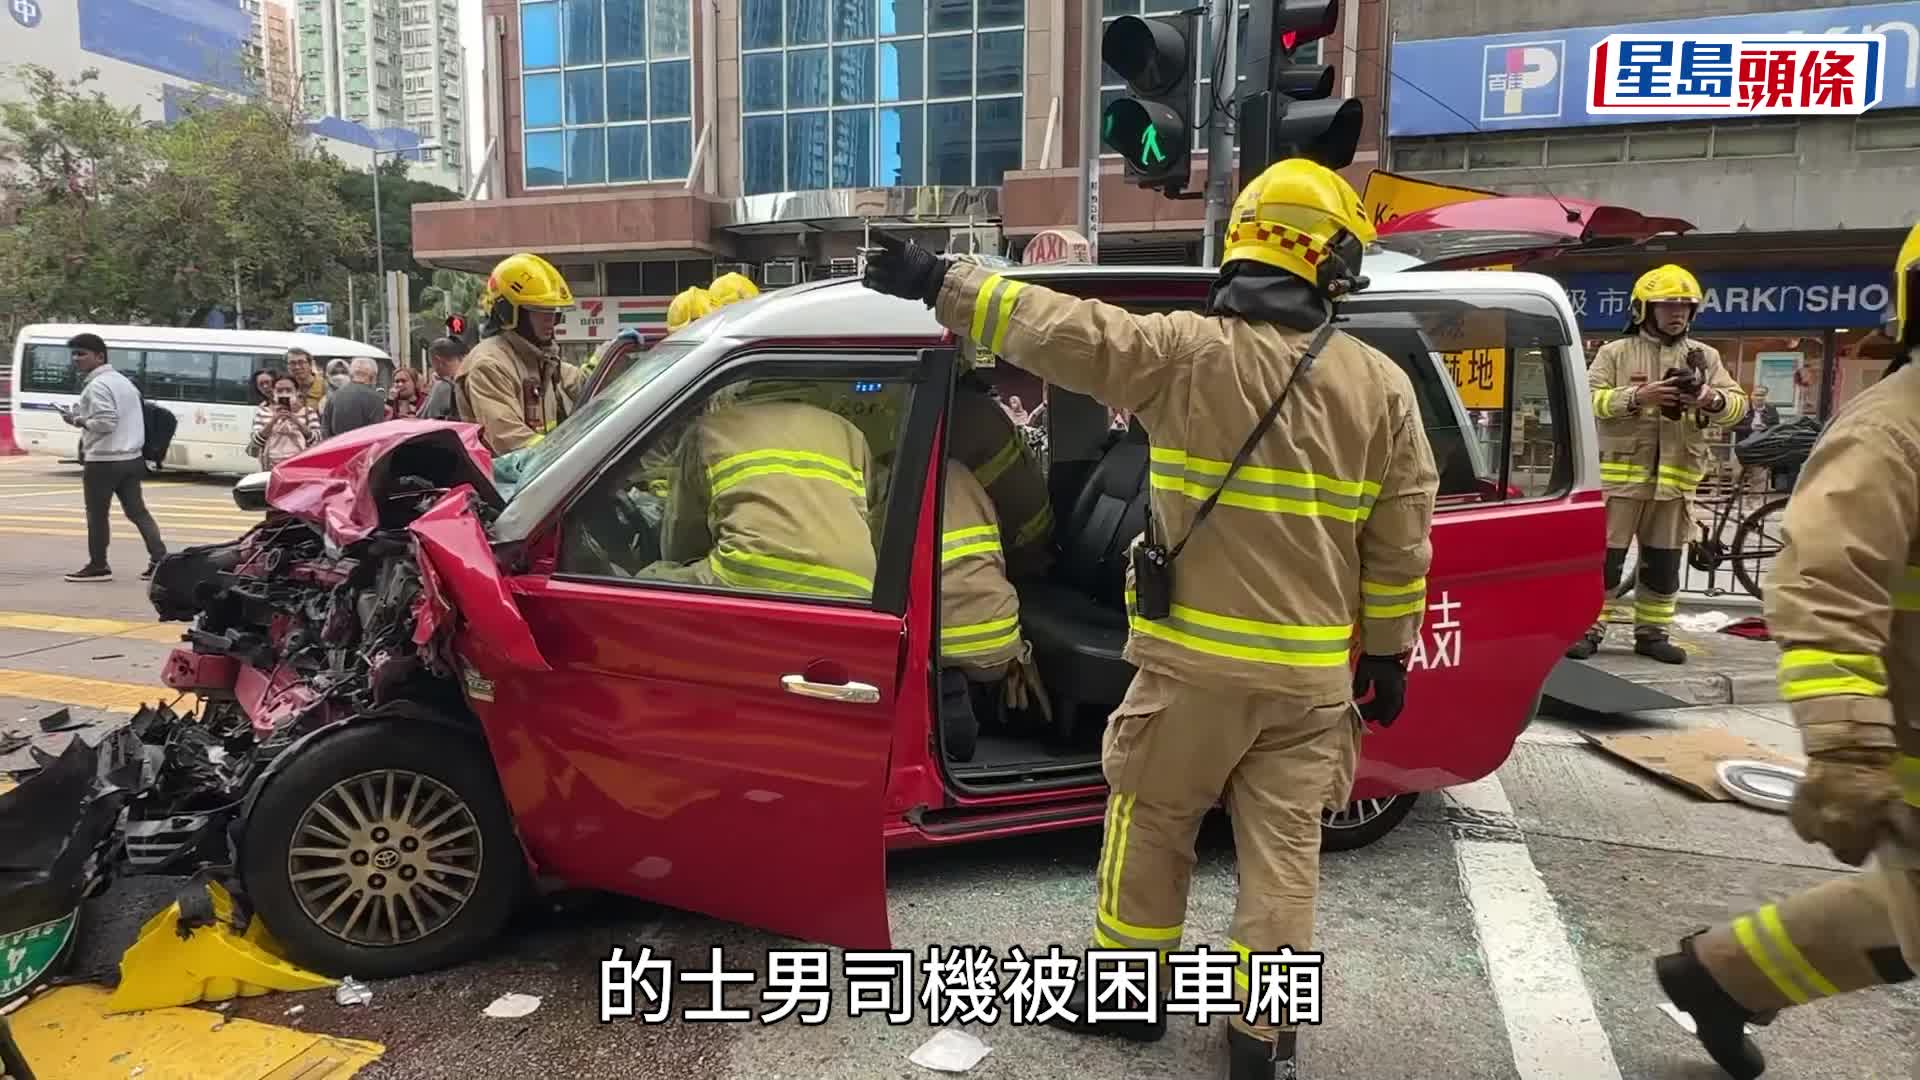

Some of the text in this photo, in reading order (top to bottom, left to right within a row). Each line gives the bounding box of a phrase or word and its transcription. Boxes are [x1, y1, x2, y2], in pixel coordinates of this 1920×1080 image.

[1027, 236, 1064, 263] TAXI
[1696, 283, 1889, 313] ARKnSHO
[1428, 590, 1462, 629] 士
[1405, 629, 1462, 672] AXI
